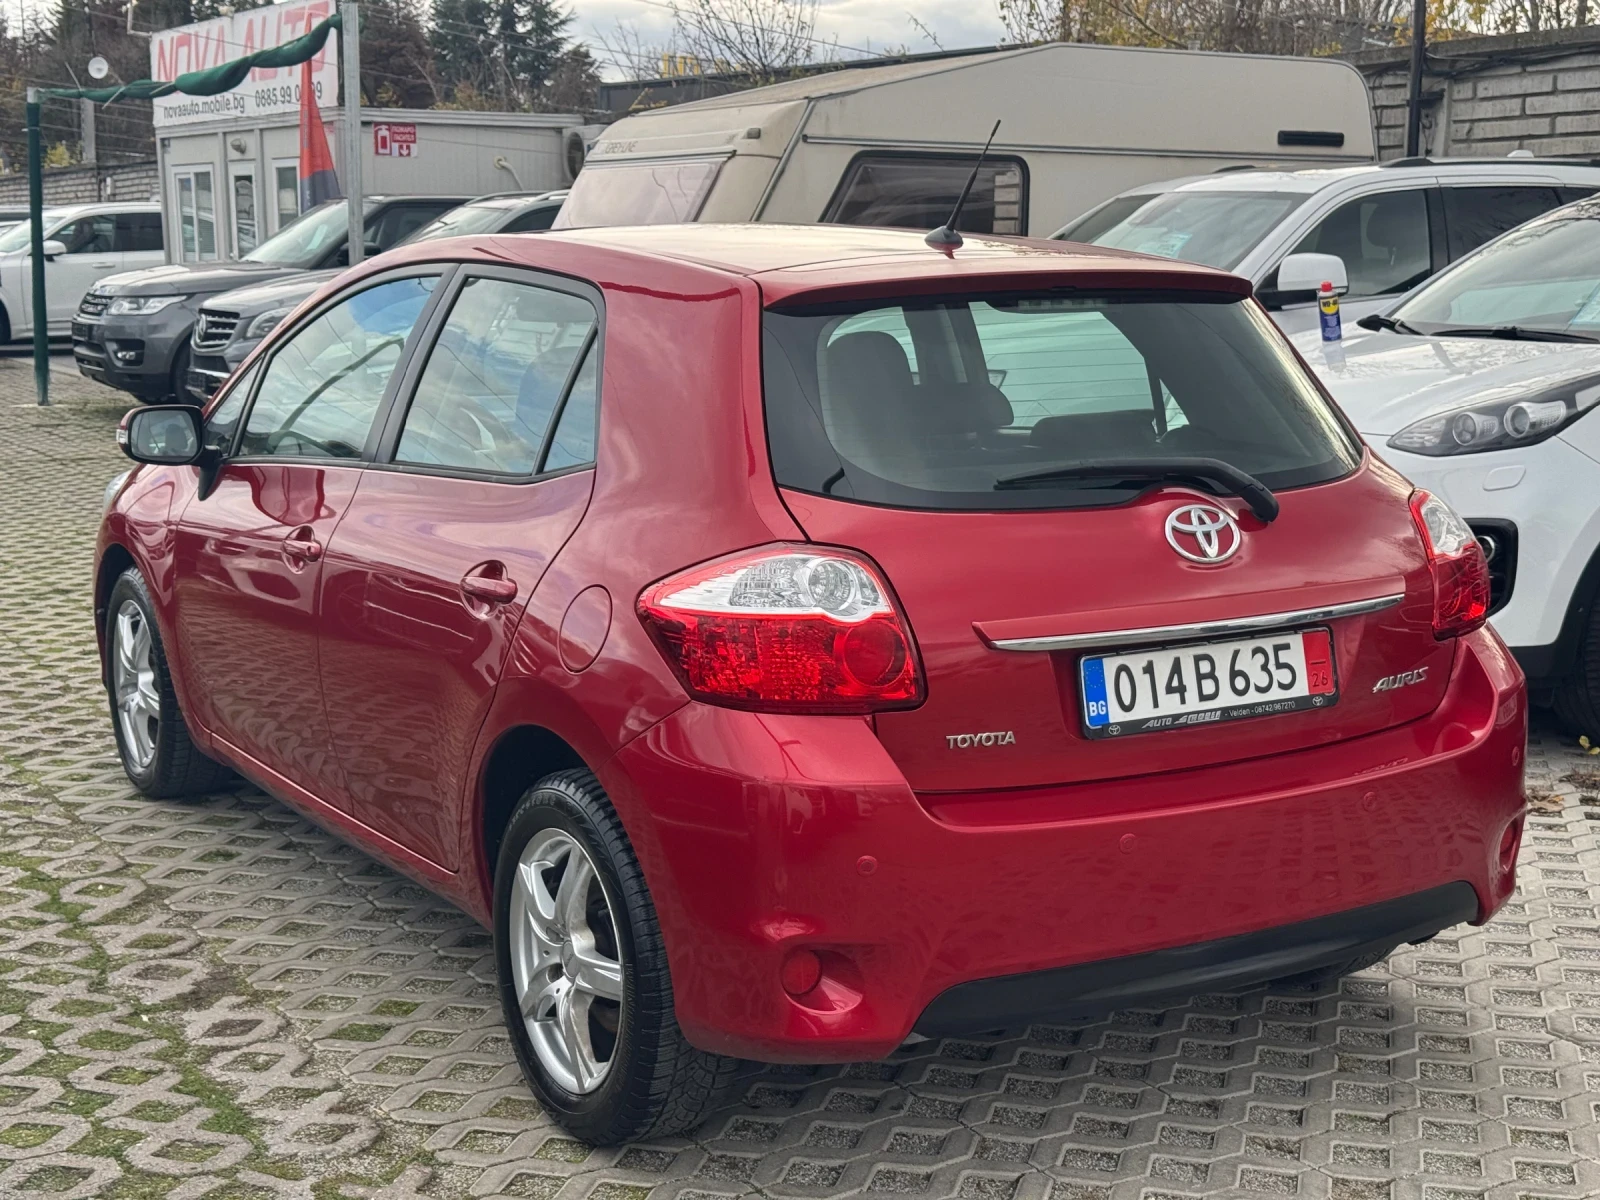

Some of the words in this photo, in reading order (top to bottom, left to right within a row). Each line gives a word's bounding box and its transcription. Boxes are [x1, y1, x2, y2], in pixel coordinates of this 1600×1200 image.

[157, 25, 226, 89] NOVA
[163, 95, 245, 119] novaauto.mobile.bg
[254, 88, 277, 108] 0885
[279, 86, 292, 104] 99
[1311, 670, 1329, 688] 26
[1372, 666, 1429, 693] AURIS
[1088, 699, 1107, 717] BG
[1141, 717, 1172, 729] AUTO
[1229, 706, 1251, 718] Velden
[945, 730, 1017, 750] TOYOTA
